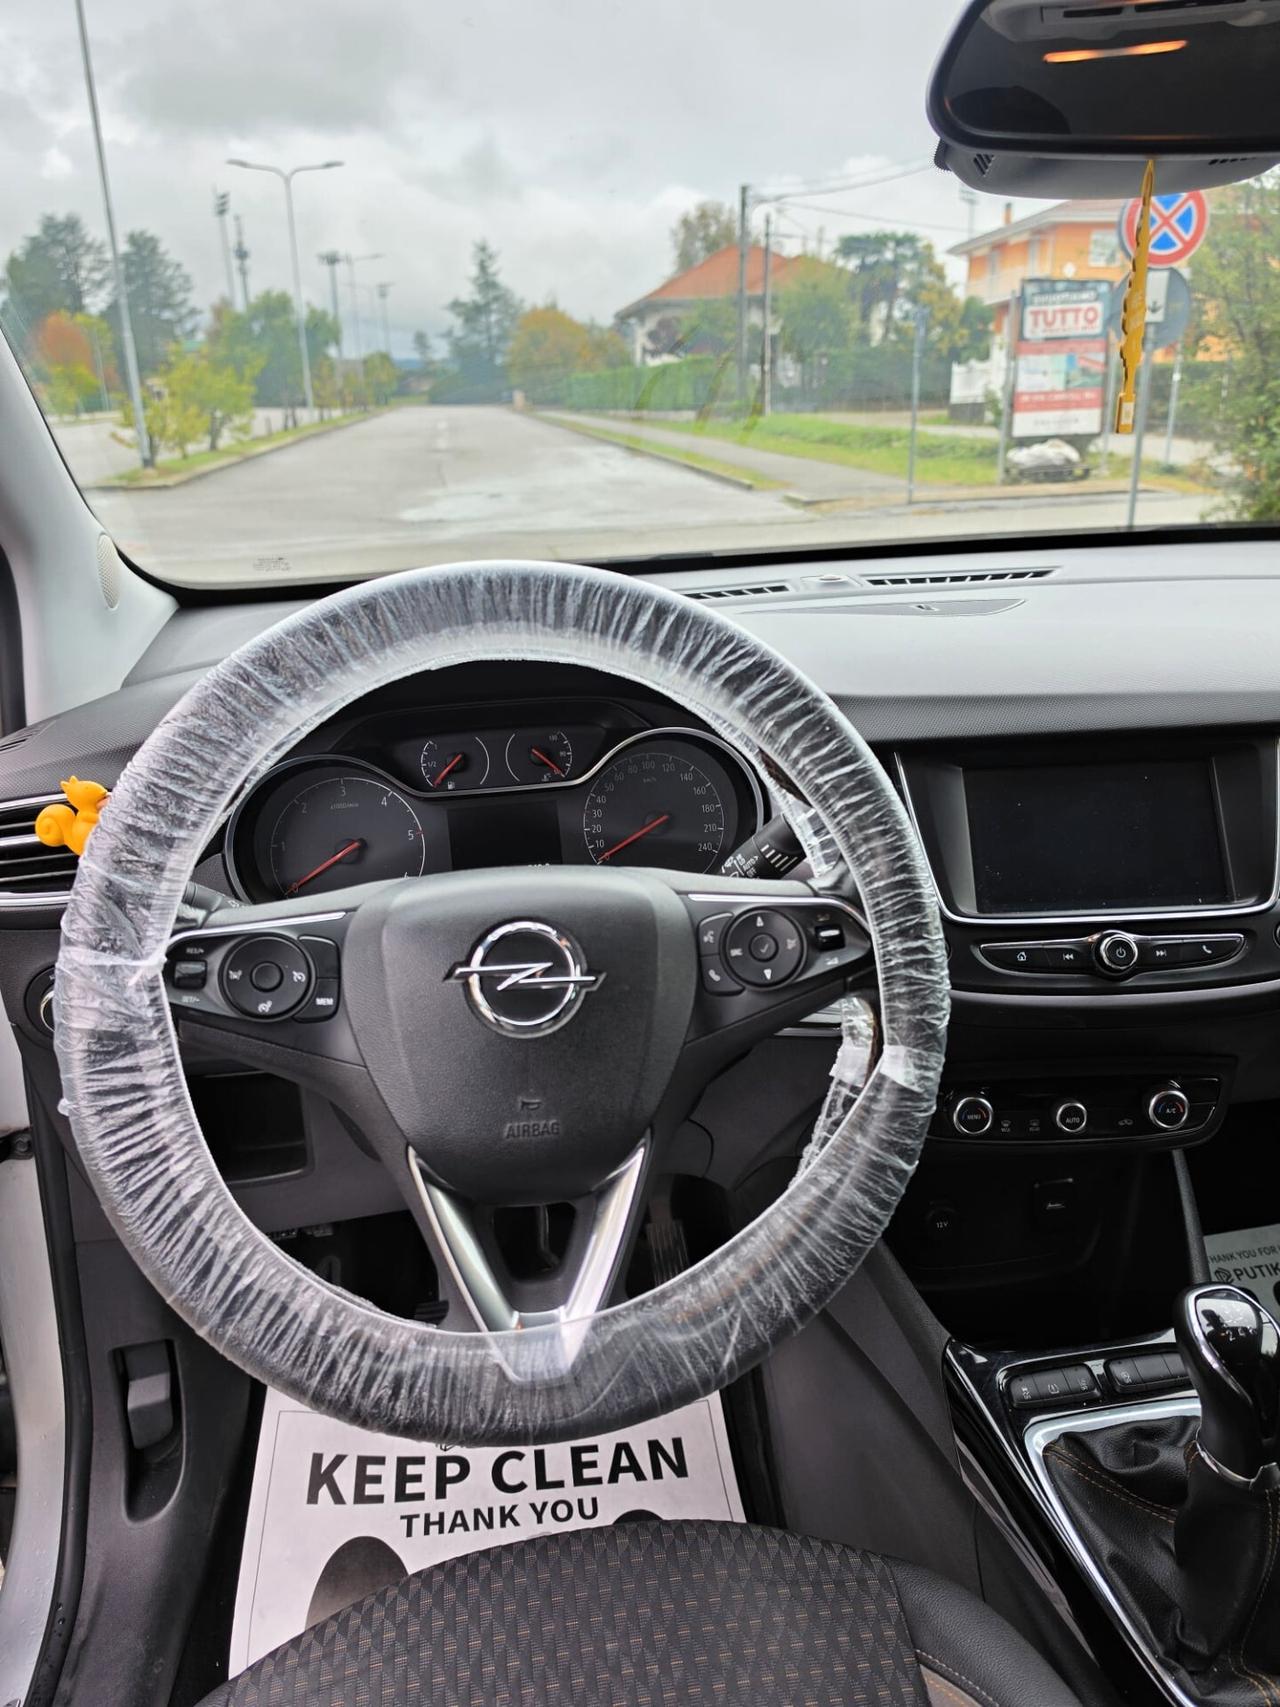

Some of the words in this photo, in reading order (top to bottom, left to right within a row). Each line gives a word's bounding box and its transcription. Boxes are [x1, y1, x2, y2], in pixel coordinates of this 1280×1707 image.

[1029, 306, 1099, 328] TUTTO
[628, 764, 638, 774] 80
[641, 760, 655, 769] 100
[662, 763, 675, 772] 120
[615, 772, 624, 781] 60
[680, 773, 693, 781] 140
[340, 786, 346, 797] 3
[604, 783, 614, 791] 50
[693, 786, 706, 795] 160
[381, 796, 387, 806] 4
[596, 795, 606, 803] 40
[301, 803, 307, 814] 2
[702, 804, 715, 813] 180
[592, 809, 602, 818] 30
[592, 824, 602, 833] 20
[704, 823, 717, 833] 210
[407, 829, 414, 840] 5
[281, 841, 286, 851] 1
[595, 839, 605, 848] 10
[698, 843, 713, 852] 240
[743, 858, 757, 872] AUTO
[504, 1119, 560, 1140] AIRBAG
[936, 1220, 949, 1229] 12V
[1208, 1252, 1236, 1264] HANK
[1236, 1248, 1257, 1260] YOU
[1257, 1244, 1276, 1256] FOR
[306, 1451, 471, 1506] KEEP
[491, 1437, 690, 1495] CLEAN
[400, 1504, 521, 1538] THANK
[529, 1496, 600, 1524] YOU
